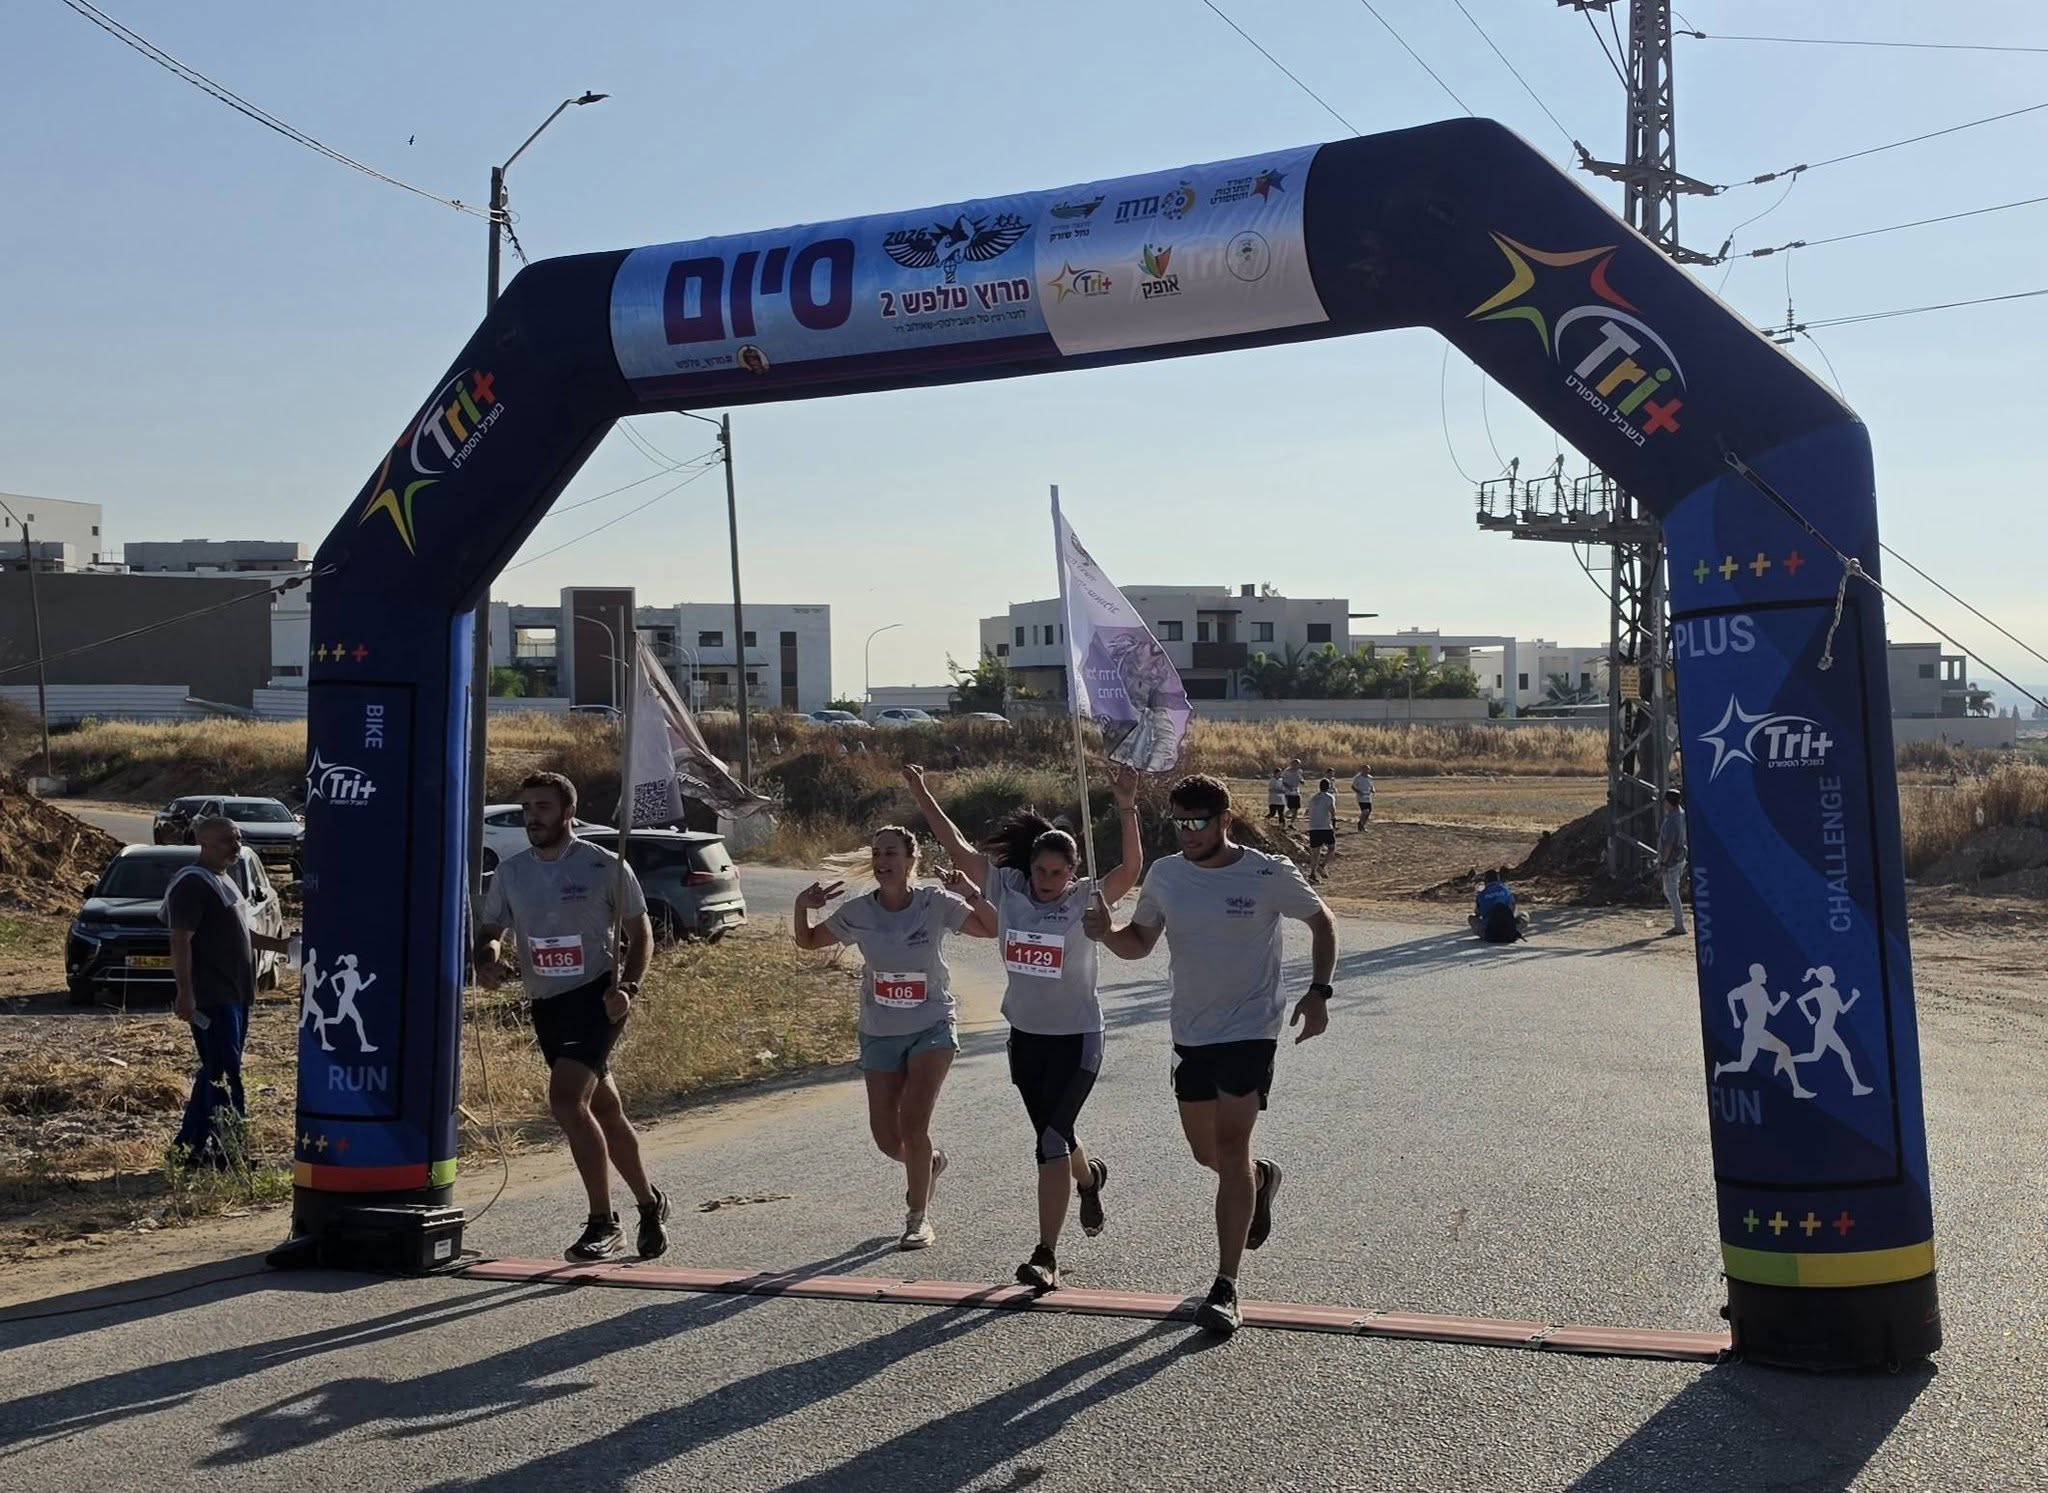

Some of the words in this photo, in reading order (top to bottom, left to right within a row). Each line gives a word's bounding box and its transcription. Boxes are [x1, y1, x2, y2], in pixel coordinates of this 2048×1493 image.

[1209, 191, 1249, 206] והספורט
[1214, 184, 1251, 199] התרבות
[1115, 195, 1160, 220] גדרה
[885, 226, 929, 245] 2026
[663, 238, 856, 346] סיום
[901, 284, 969, 317] טלפש
[974, 278, 1030, 310] מרוץ
[1141, 276, 1182, 300] אופק
[880, 291, 897, 318] 2
[1573, 319, 1684, 436] Tri+
[1565, 374, 1610, 417] הספורט
[477, 402, 505, 434] בשביל
[1609, 409, 1647, 449] בשביל
[451, 430, 483, 470] הספורט
[1675, 614, 1757, 660] PLUS
[364, 703, 385, 750] BIKE
[1763, 724, 1834, 761] Tri+
[1768, 759, 1799, 769] הספורט
[1800, 757, 1825, 768] בשביל
[329, 771, 377, 801] Tri+
[1819, 776, 1852, 932] CHALLENGE
[1692, 865, 1714, 967] SWIM
[537, 952, 575, 967] 1136
[1014, 947, 1053, 967] 1129
[886, 985, 913, 999] 106
[328, 1064, 388, 1093] RUN
